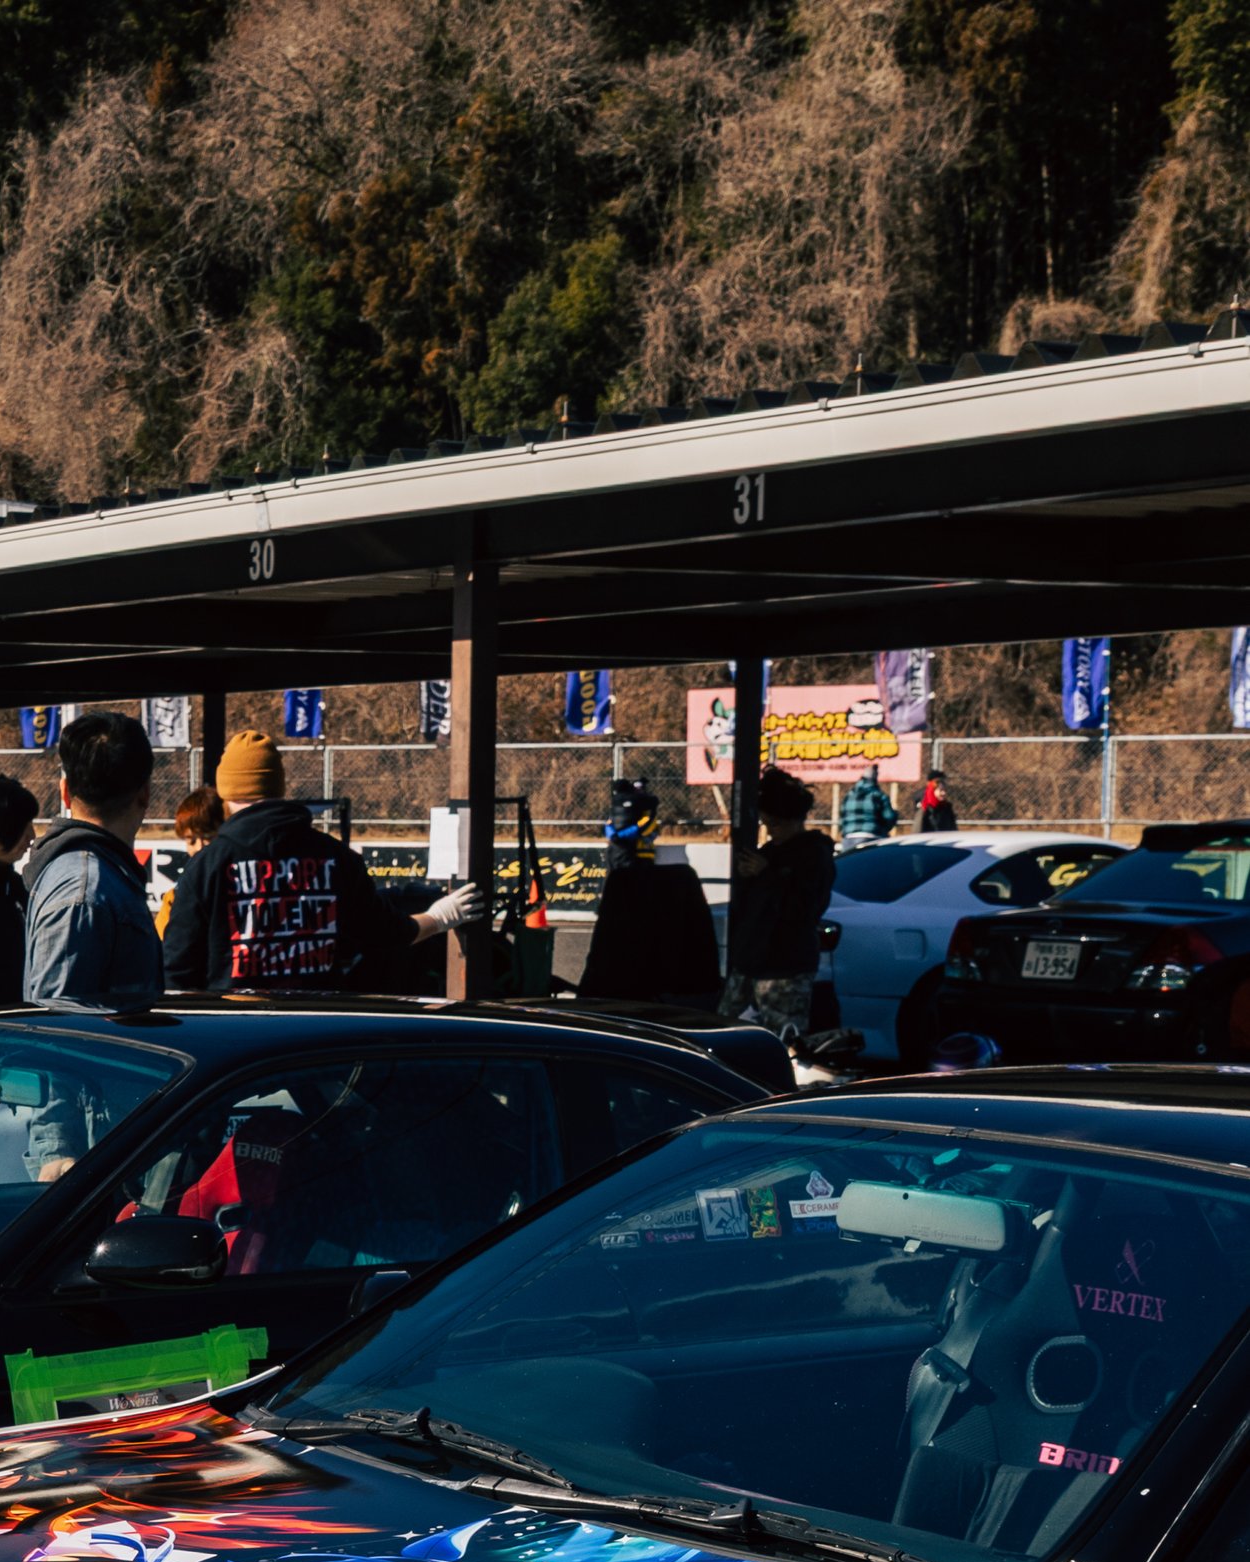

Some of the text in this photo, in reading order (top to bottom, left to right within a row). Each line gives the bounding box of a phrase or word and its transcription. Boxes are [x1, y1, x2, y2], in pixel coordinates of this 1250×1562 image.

[733, 474, 766, 525] 31
[249, 539, 275, 580] 30
[226, 857, 336, 896] SUPPORT
[228, 895, 338, 941] VIOLENT
[230, 938, 337, 979] DRIVING
[1072, 1283, 1167, 1323] VERTEX
[108, 1395, 159, 1411] WONDER
